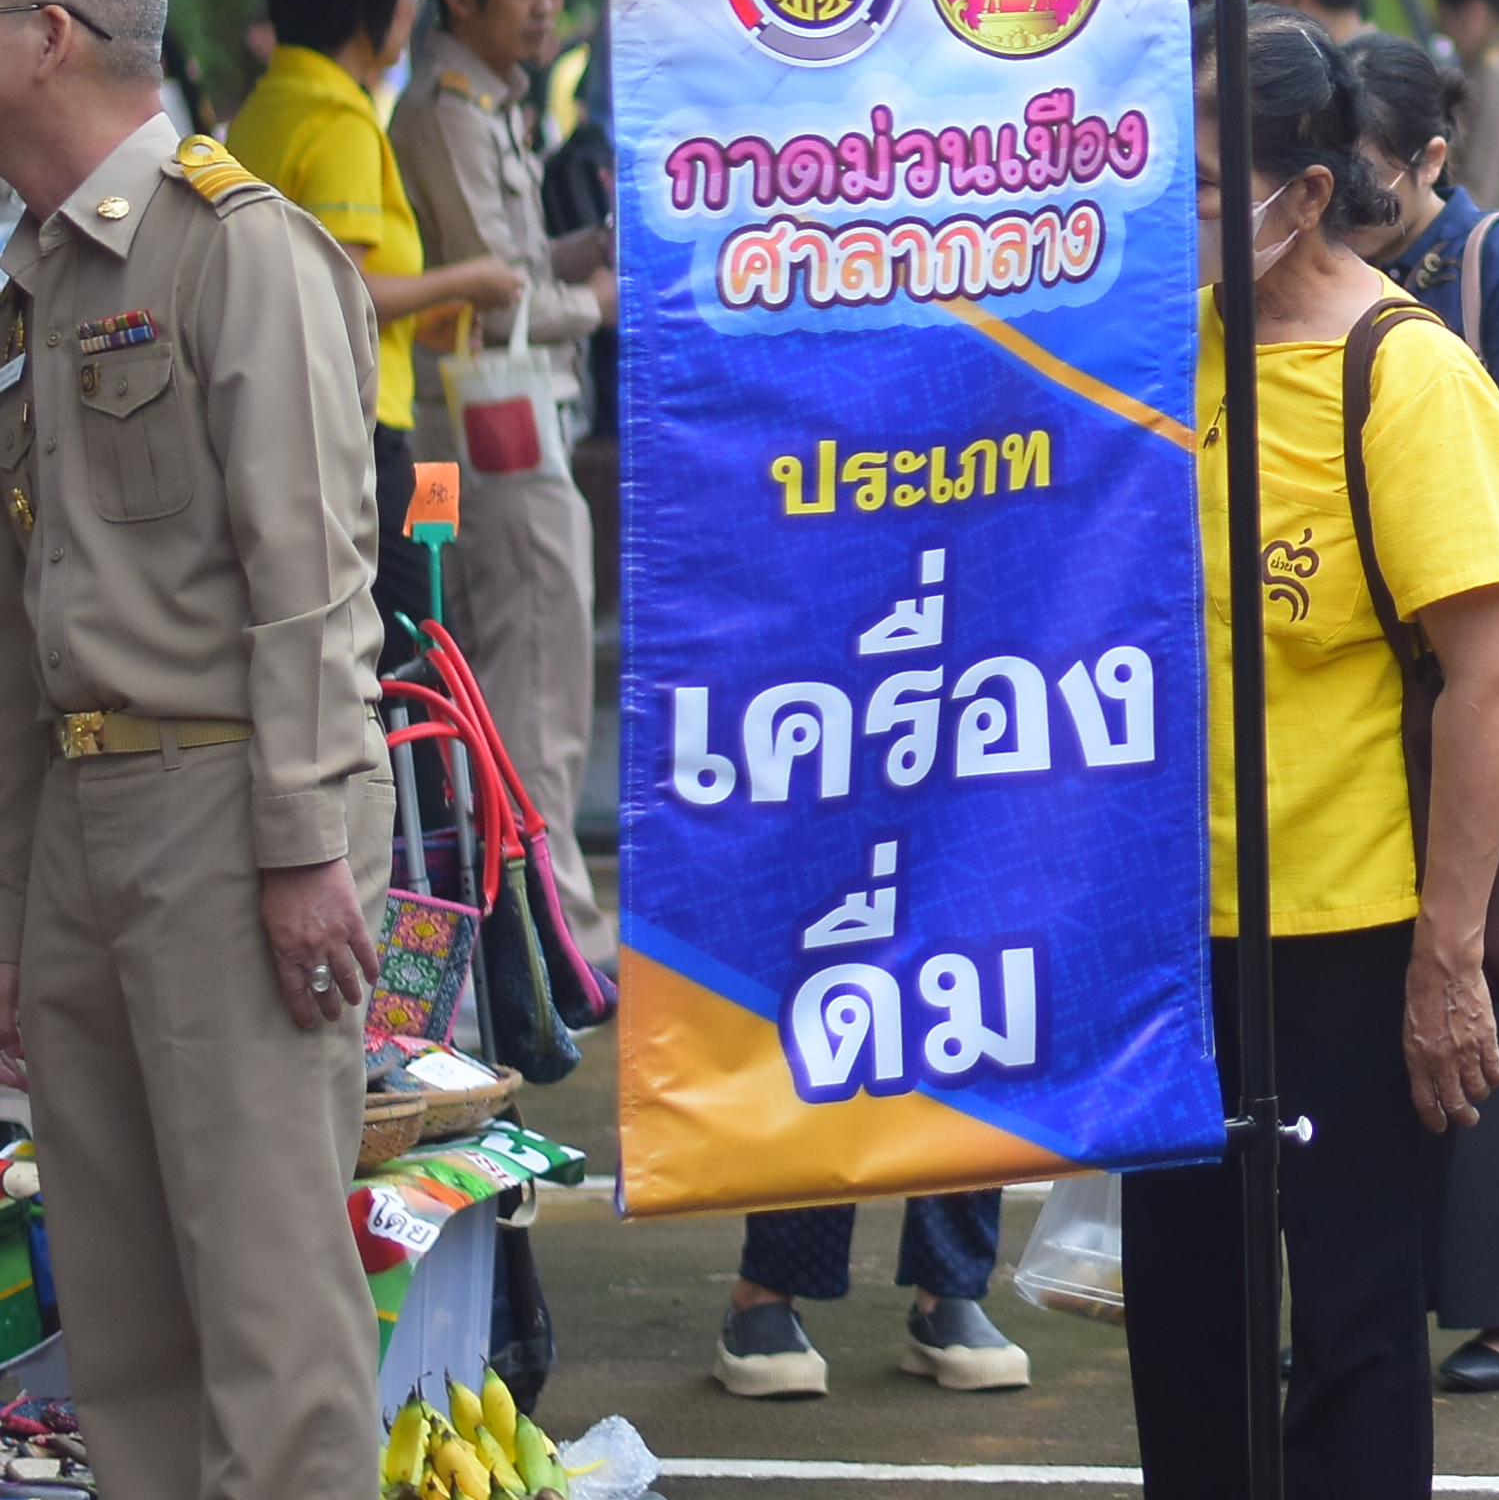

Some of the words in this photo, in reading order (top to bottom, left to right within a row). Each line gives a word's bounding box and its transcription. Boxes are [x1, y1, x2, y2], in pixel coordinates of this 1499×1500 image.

[665, 89, 1149, 211] กาดม่วนเมือง
[721, 201, 1104, 307] ศาลากลาง
[770, 429, 1051, 516] ประเภท
[671, 548, 1158, 806] เครื่อง
[792, 841, 1037, 1088] ดื่ม
